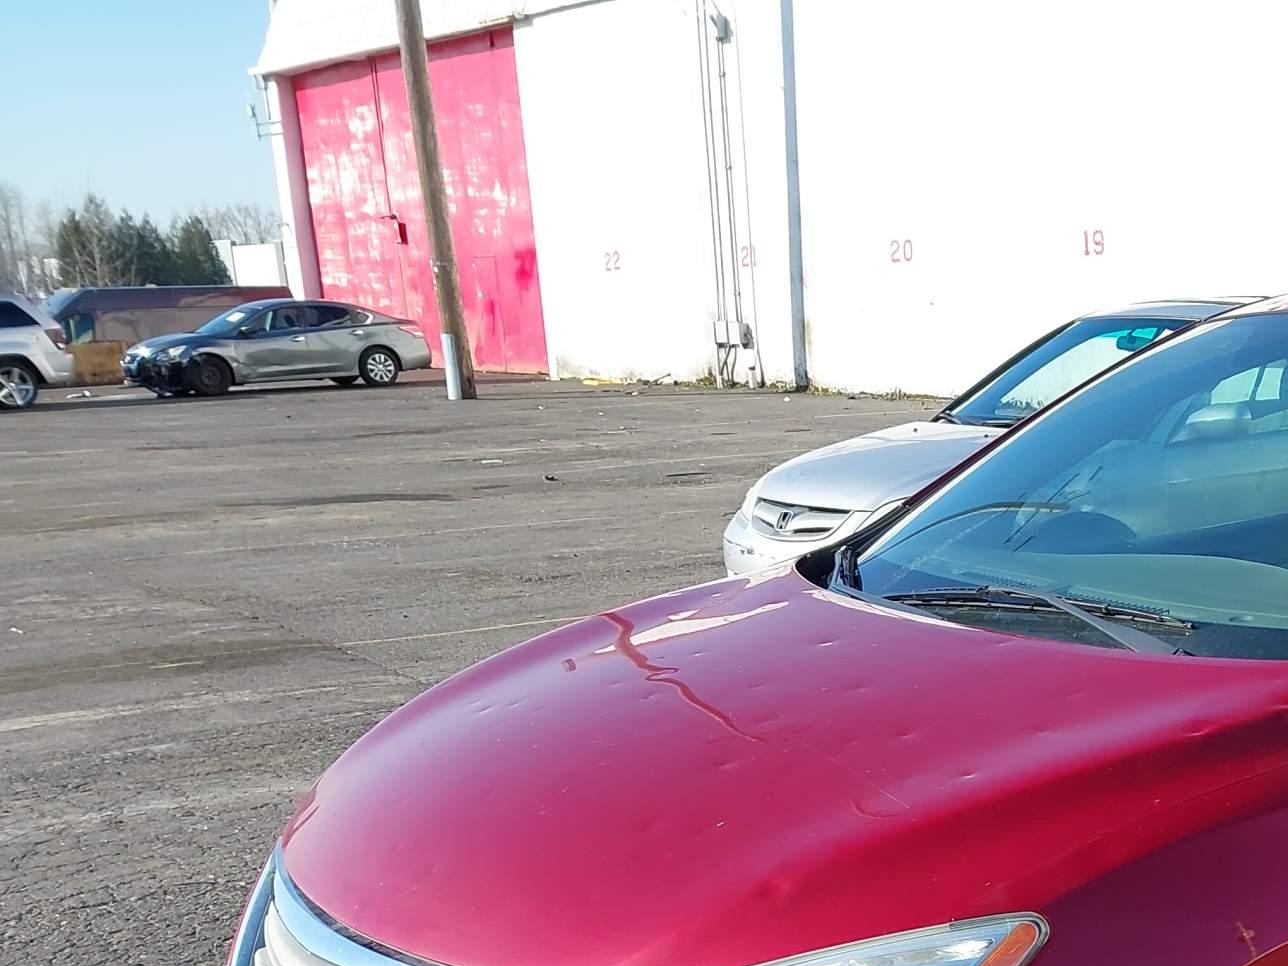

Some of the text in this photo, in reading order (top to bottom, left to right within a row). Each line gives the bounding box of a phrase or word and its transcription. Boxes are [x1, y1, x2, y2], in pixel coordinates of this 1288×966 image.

[890, 239, 913, 262] 20
[1083, 229, 1105, 256] 19
[604, 250, 622, 271] 22
[741, 246, 757, 267] 21
